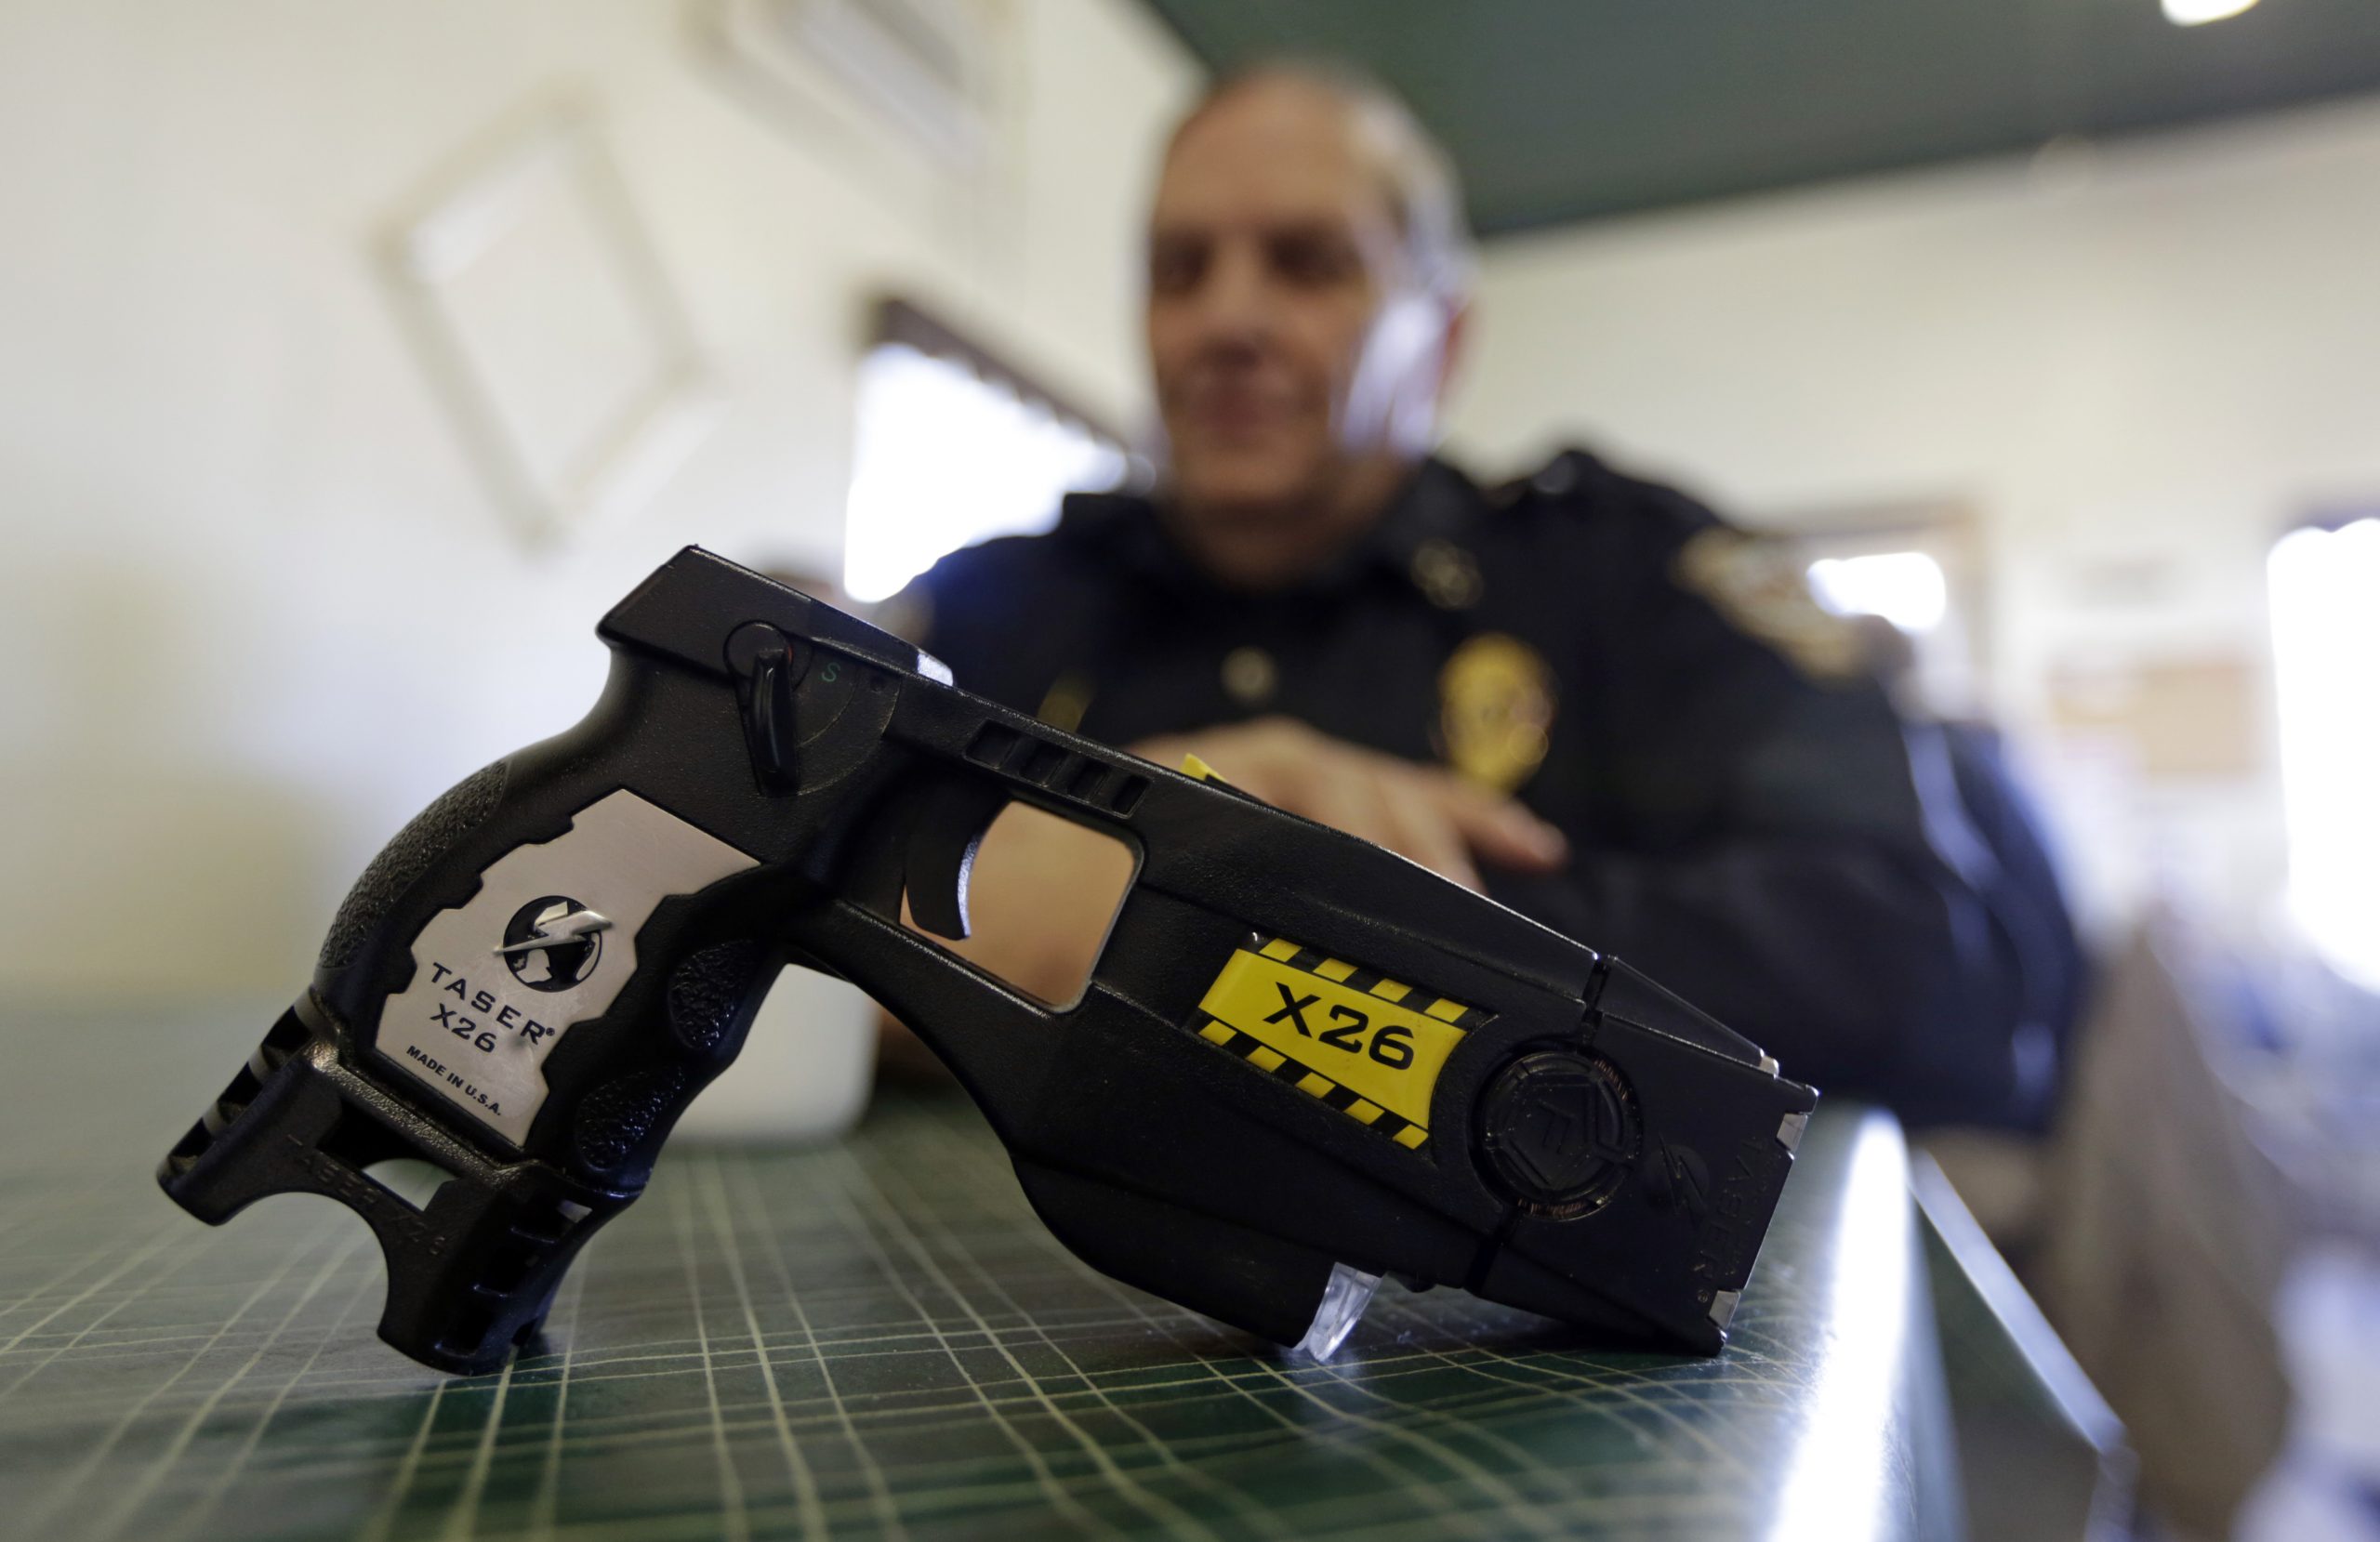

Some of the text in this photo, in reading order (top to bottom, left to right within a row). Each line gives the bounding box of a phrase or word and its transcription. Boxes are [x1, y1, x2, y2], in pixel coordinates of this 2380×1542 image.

[430, 1003, 497, 1053] X26
[1263, 981, 1415, 1071] X26
[406, 1045, 502, 1115] MADE IN U.S.A.
